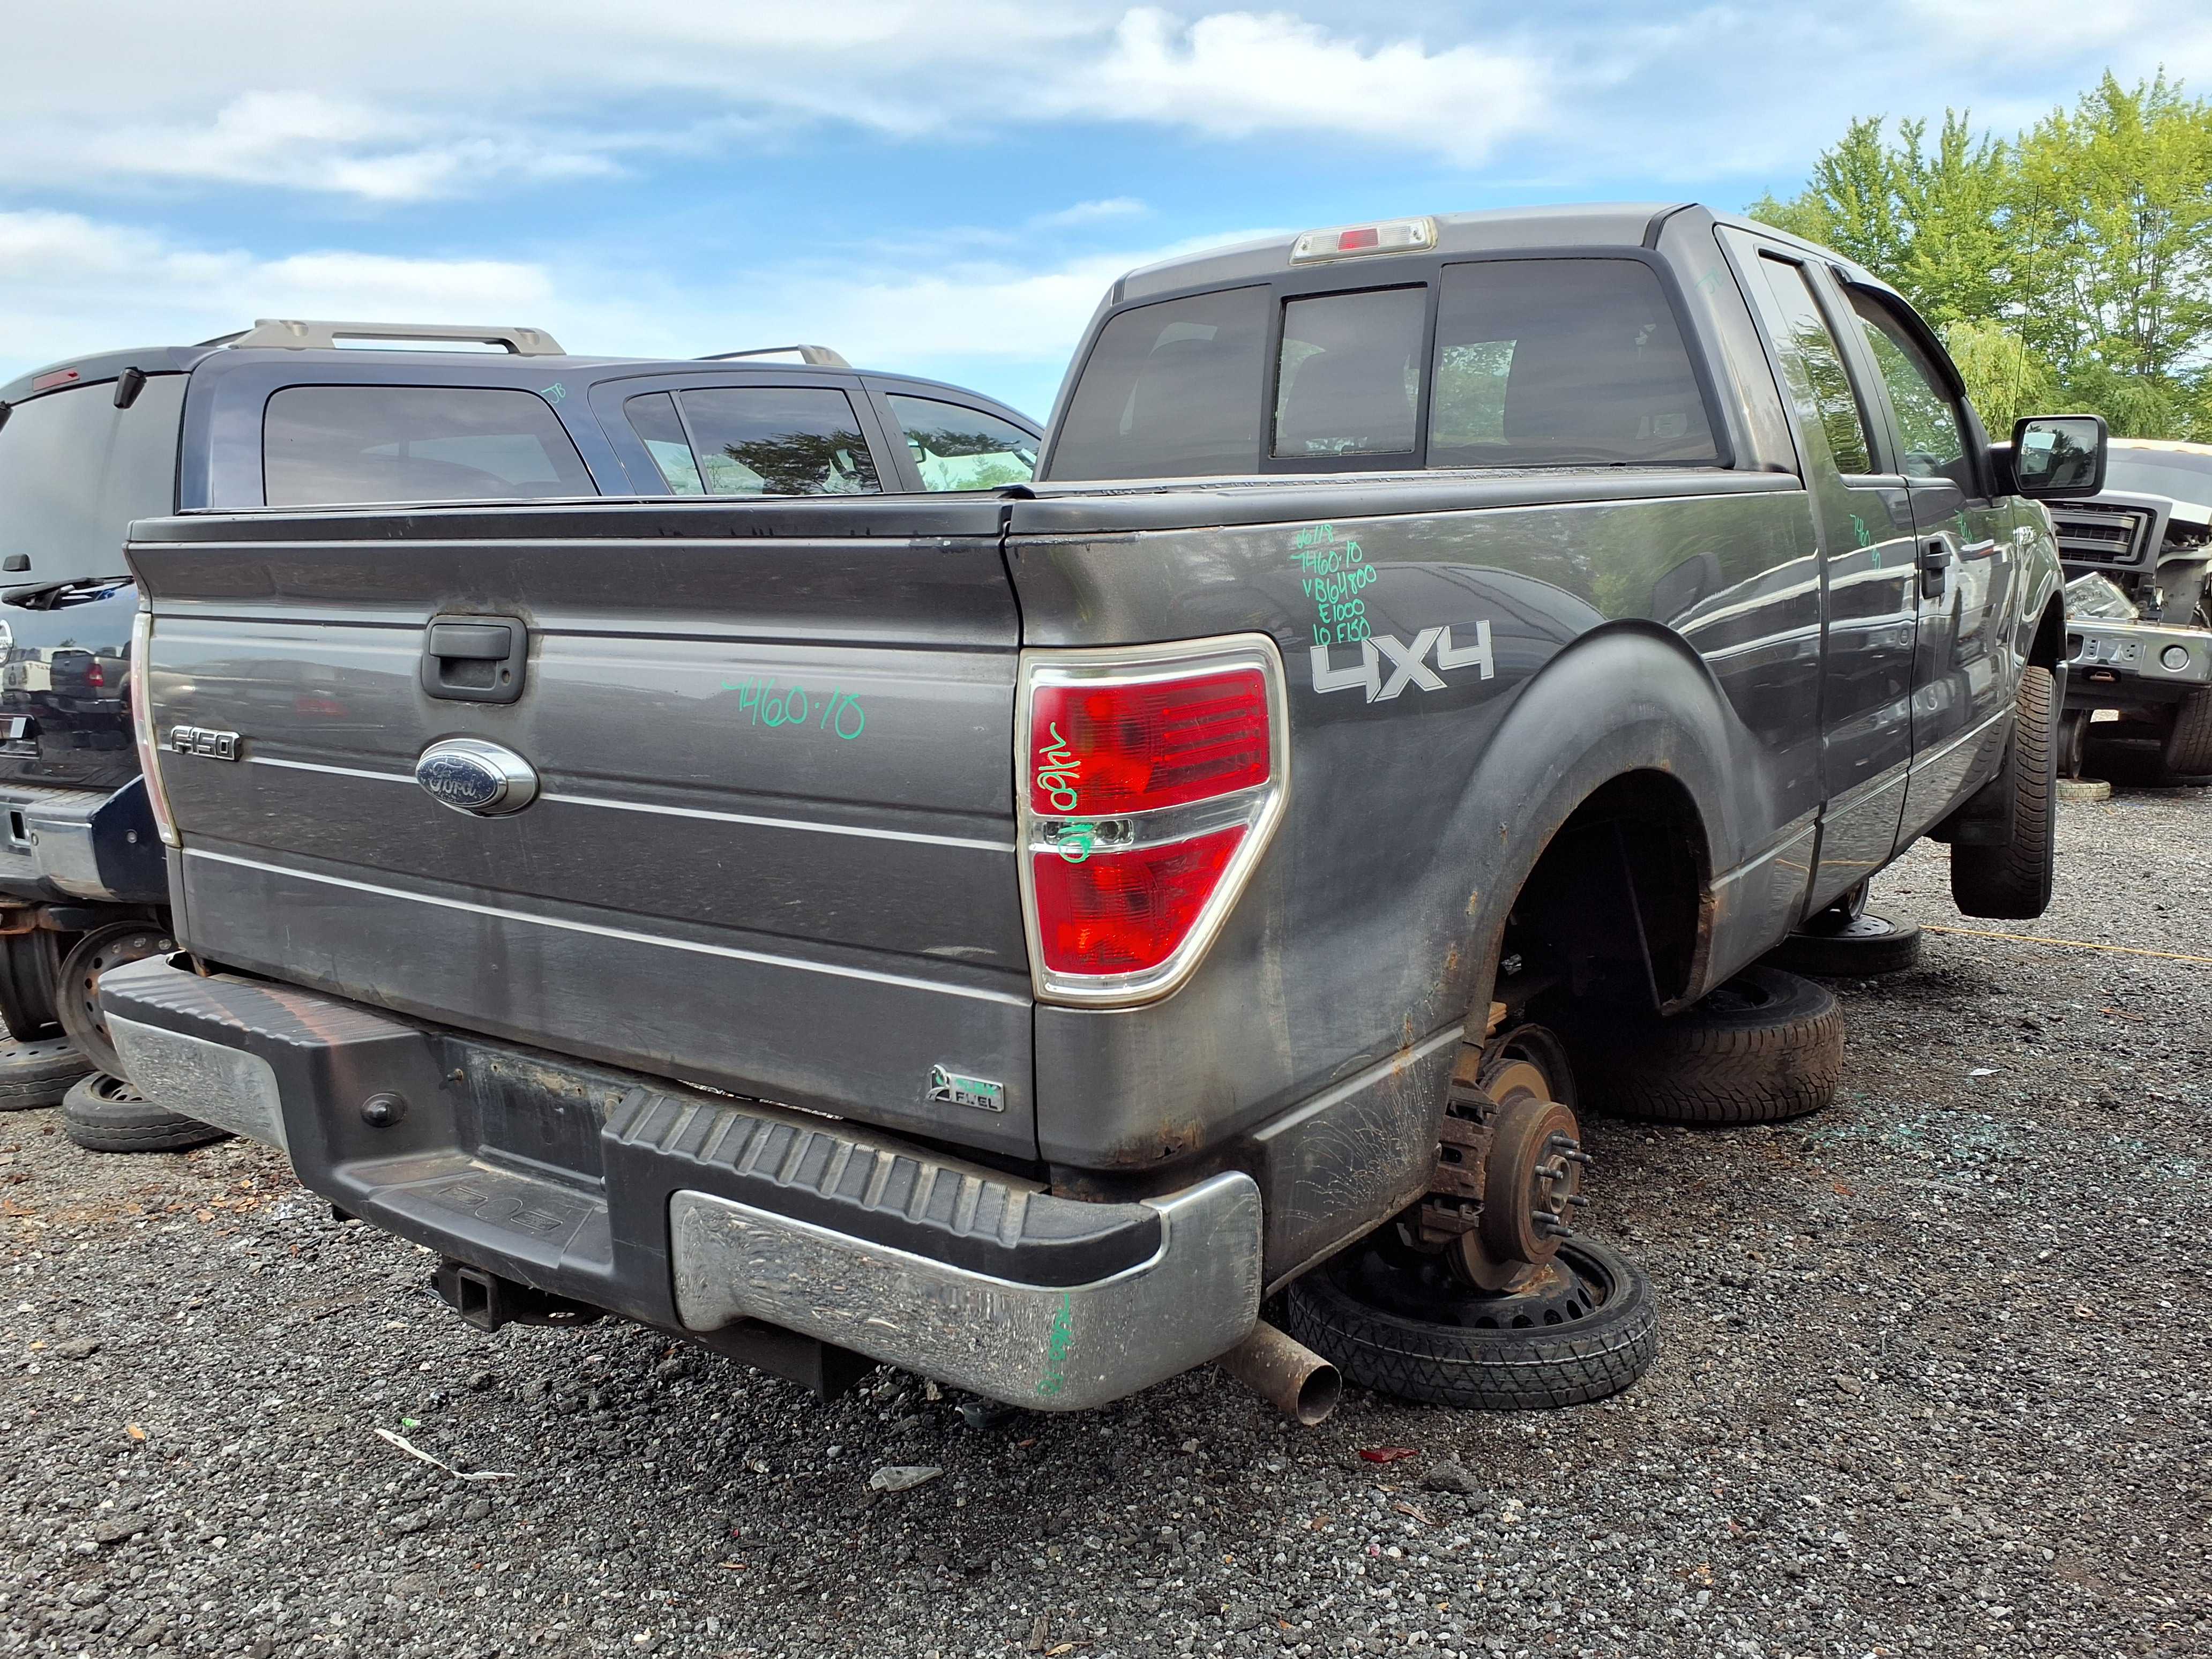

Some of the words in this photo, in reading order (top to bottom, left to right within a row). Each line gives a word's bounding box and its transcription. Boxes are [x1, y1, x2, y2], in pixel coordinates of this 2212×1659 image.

[1337, 616, 1371, 644] F150
[429, 761, 476, 797] Ford
[955, 1090, 998, 1110] FUEL
